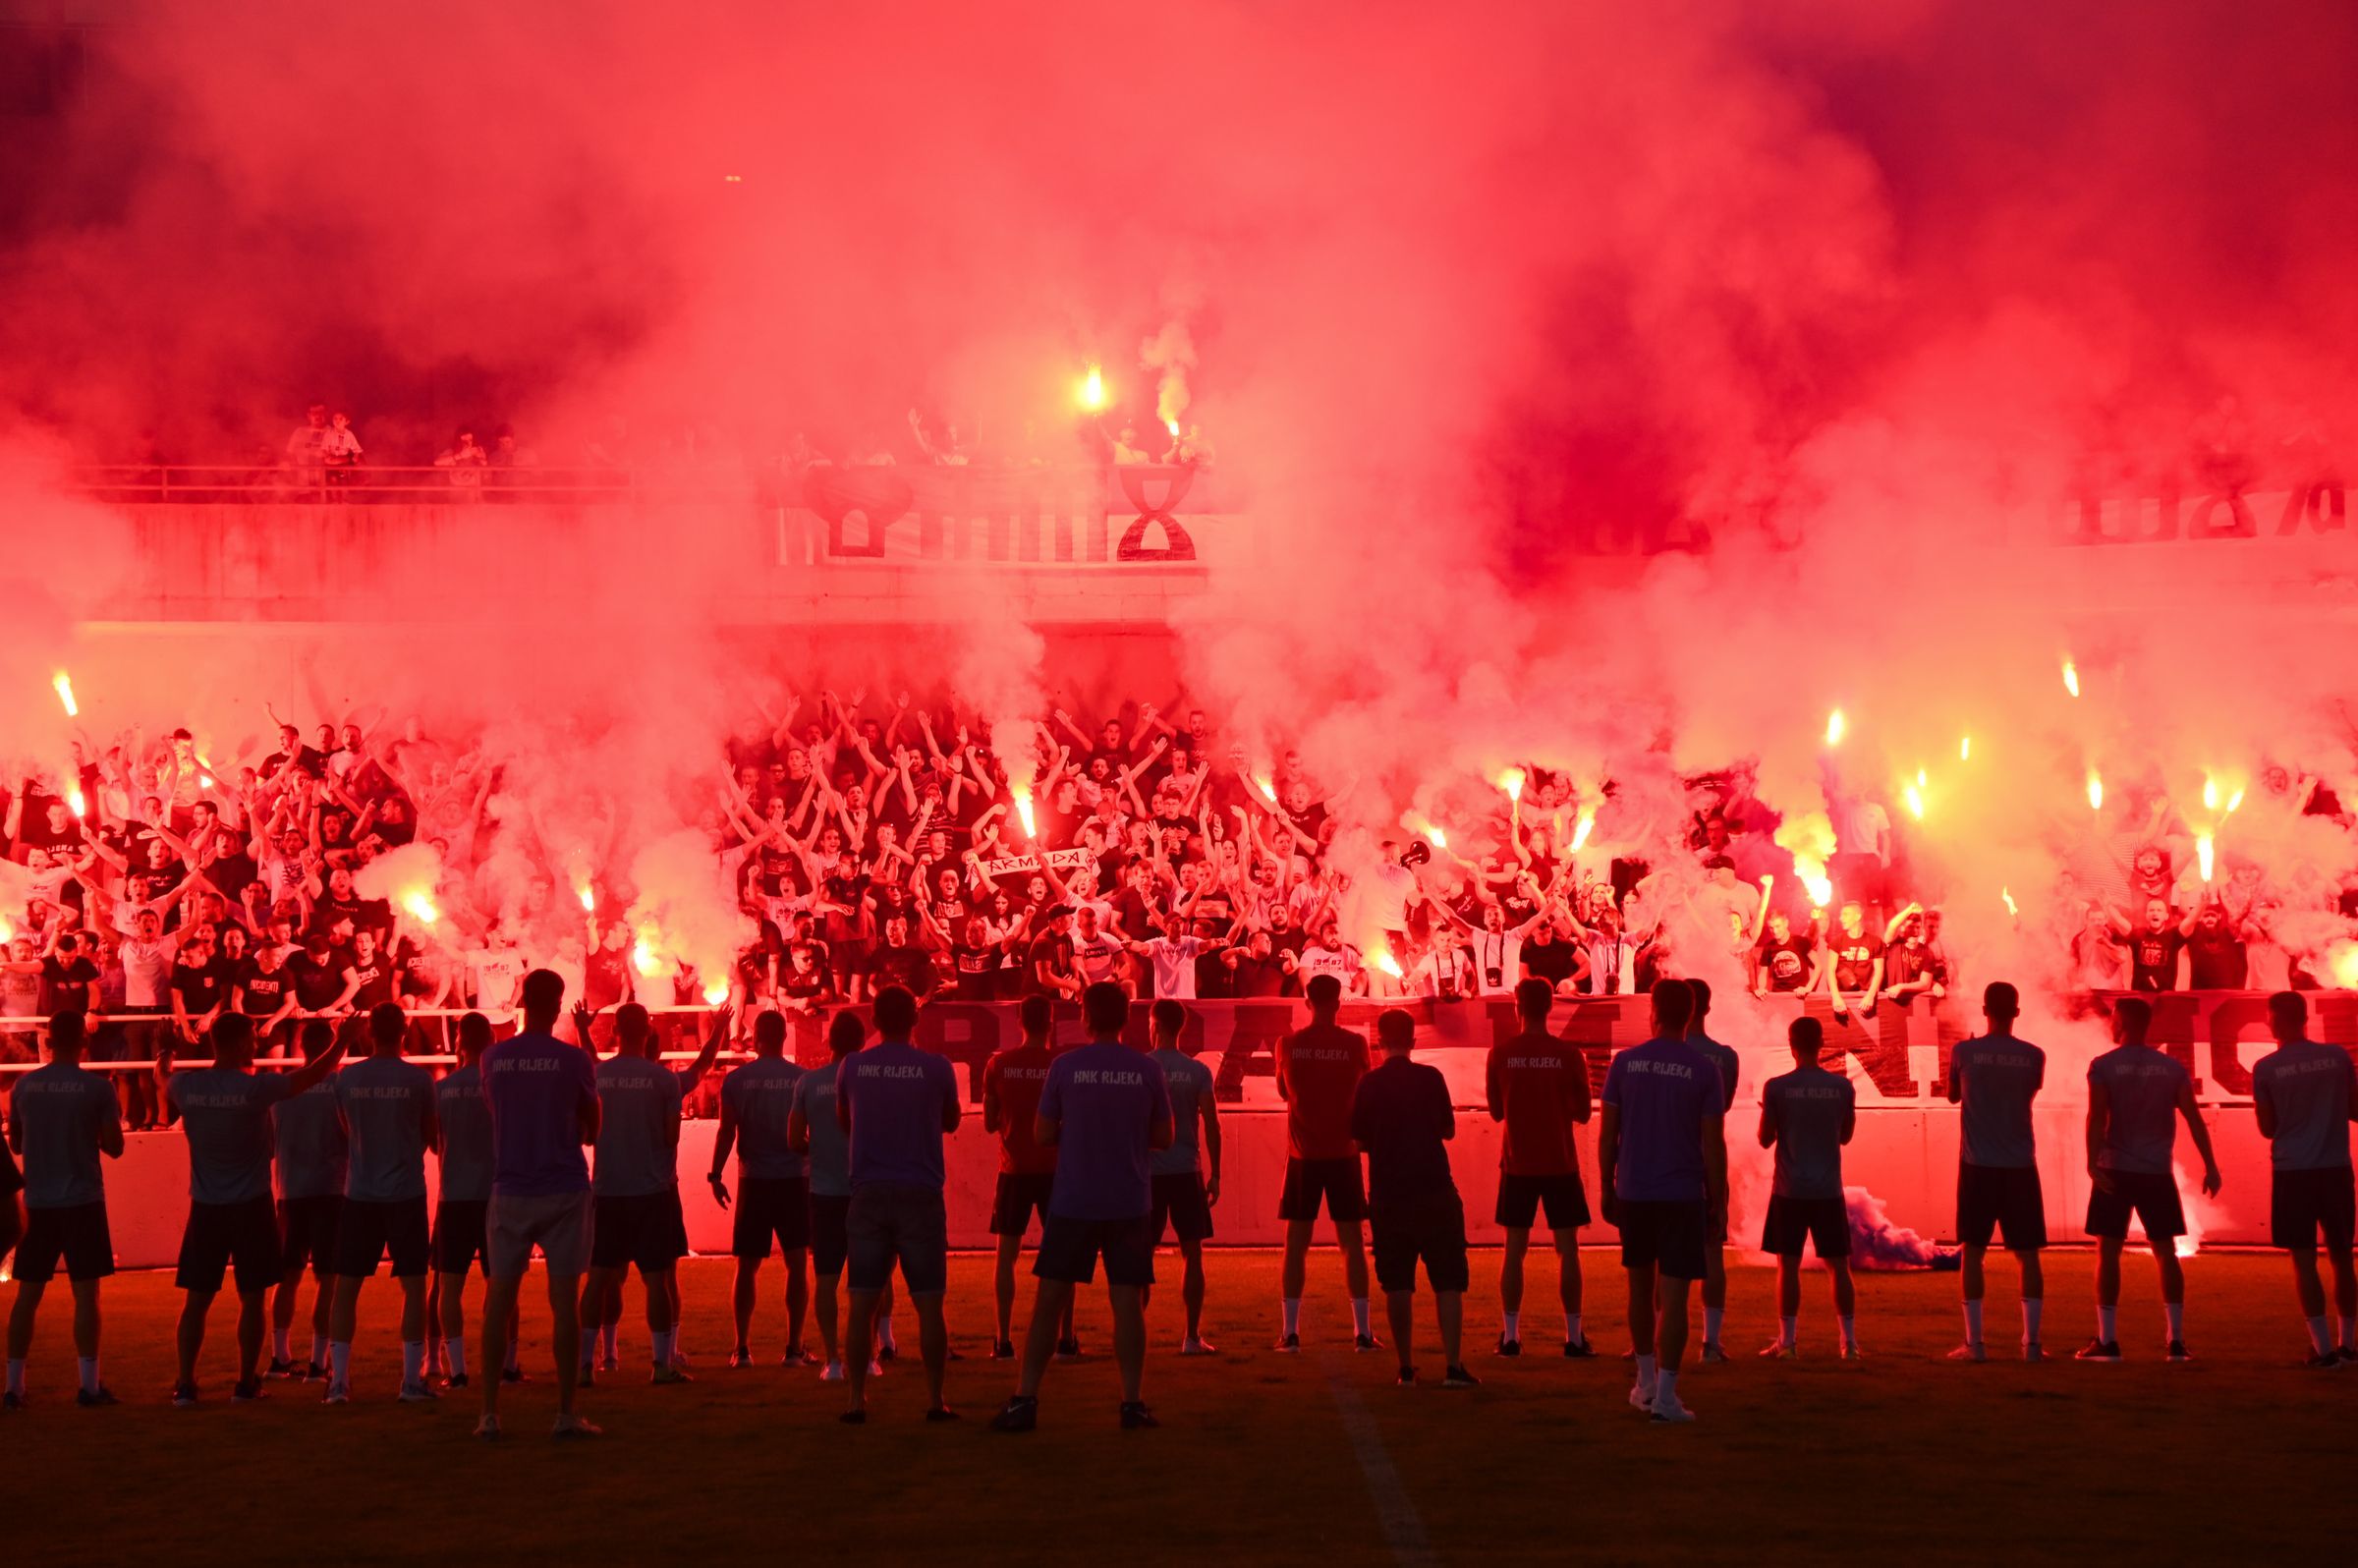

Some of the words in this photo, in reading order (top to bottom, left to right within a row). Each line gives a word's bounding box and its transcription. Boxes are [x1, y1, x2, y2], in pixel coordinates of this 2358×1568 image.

[1292, 1047, 1313, 1060] HNK
[1315, 1048, 1349, 1061] RIJEKA
[1996, 1053, 2032, 1067] RIJEKA
[492, 1058, 516, 1072] HNK
[519, 1058, 560, 1072] RIJEKA
[1507, 1056, 1527, 1069] HNK
[1529, 1056, 1562, 1069] RIJEKA
[2299, 1058, 2337, 1073] RIJEKA
[858, 1064, 880, 1078] HNK
[883, 1065, 924, 1079] RIJEKA
[1003, 1067, 1024, 1079] HNK
[1026, 1068, 1049, 1080] RIJE
[1627, 1060, 1651, 1074] HNK
[1653, 1061, 1693, 1080] RIJEKA
[618, 1078, 653, 1090] RIJEKA
[1073, 1070, 1097, 1084] HNK
[1101, 1070, 1143, 1086] RIJEKA
[350, 1087, 370, 1098] HNK
[373, 1087, 411, 1098] RIJEKA
[1808, 1087, 1840, 1099] RIJEKA
